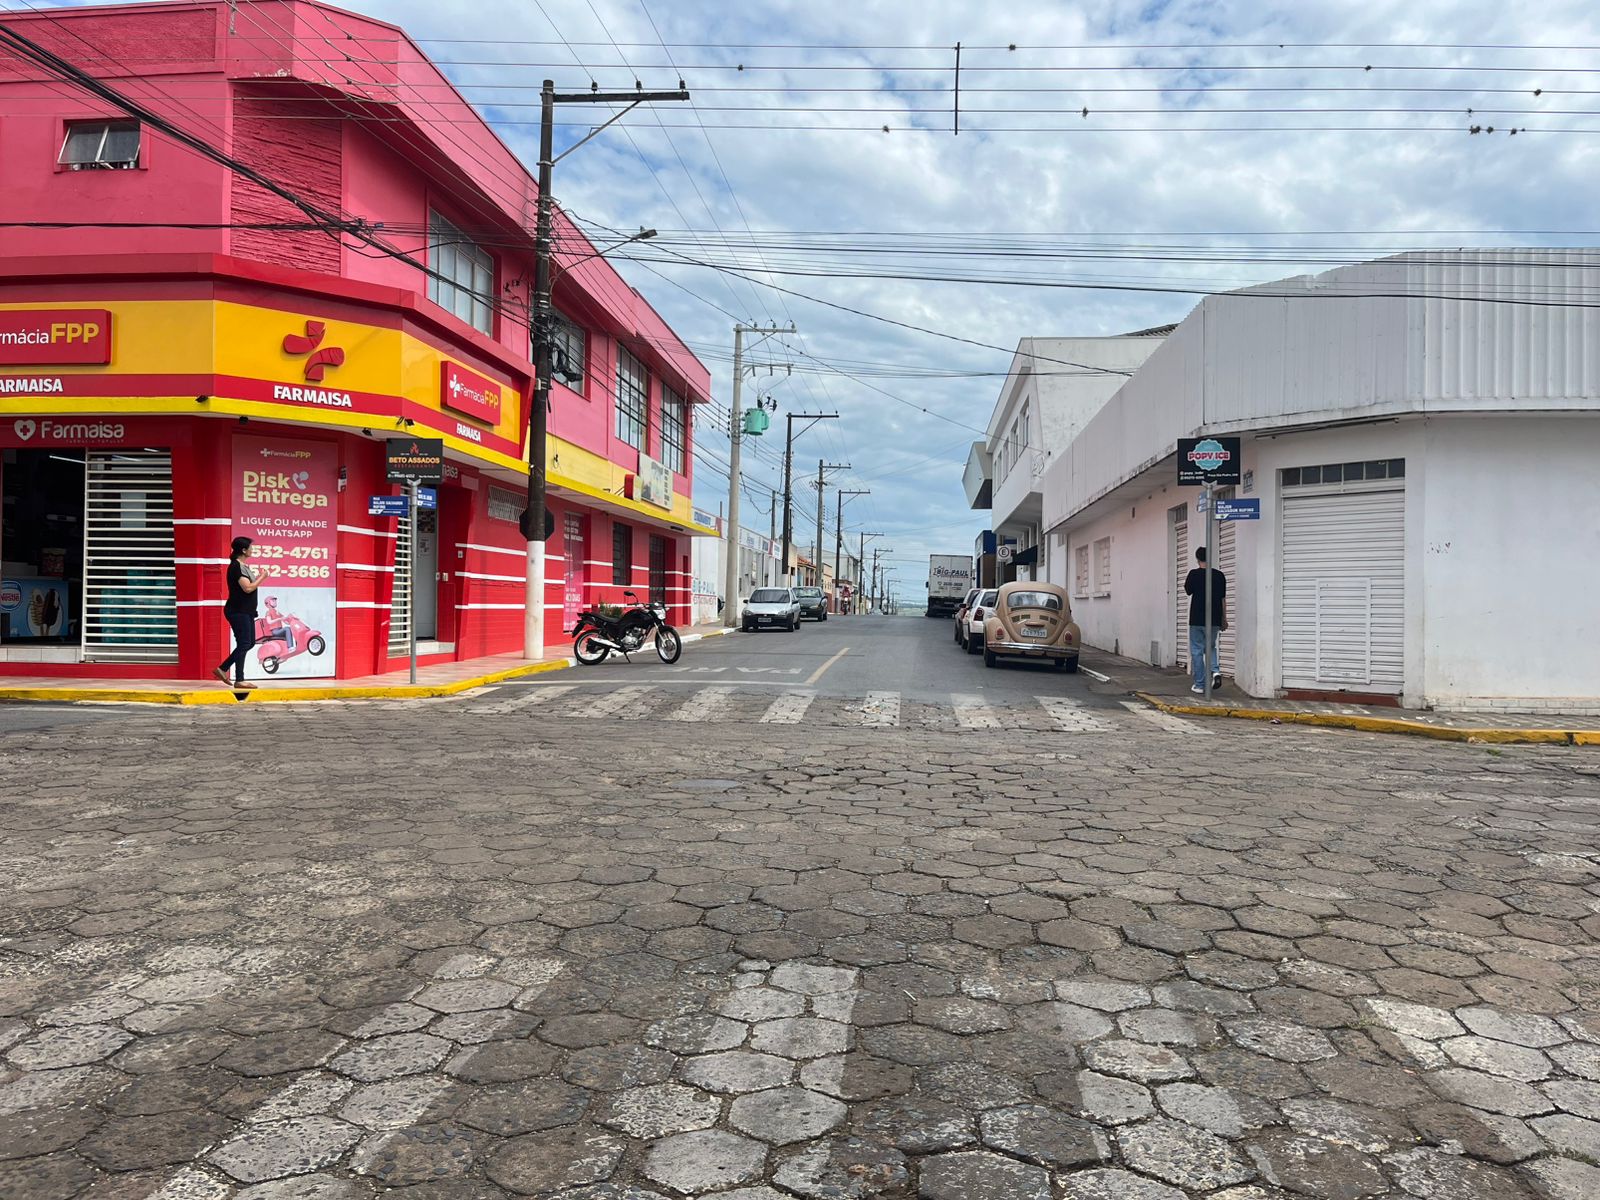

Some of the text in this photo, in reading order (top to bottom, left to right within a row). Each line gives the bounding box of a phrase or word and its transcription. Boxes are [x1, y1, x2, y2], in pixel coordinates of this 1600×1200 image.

[273, 385, 353, 408] FARMAISA
[41, 421, 125, 439] Farmaisa
[456, 422, 481, 443] FARMAISA
[388, 456, 440, 465] BETO ASSADOS
[1215, 451, 1229, 460] ICE
[243, 470, 290, 489] Disk
[243, 486, 328, 509] Entrega
[240, 516, 328, 529] LIGUE OU MANDE
[256, 528, 313, 538] WHATSAPP
